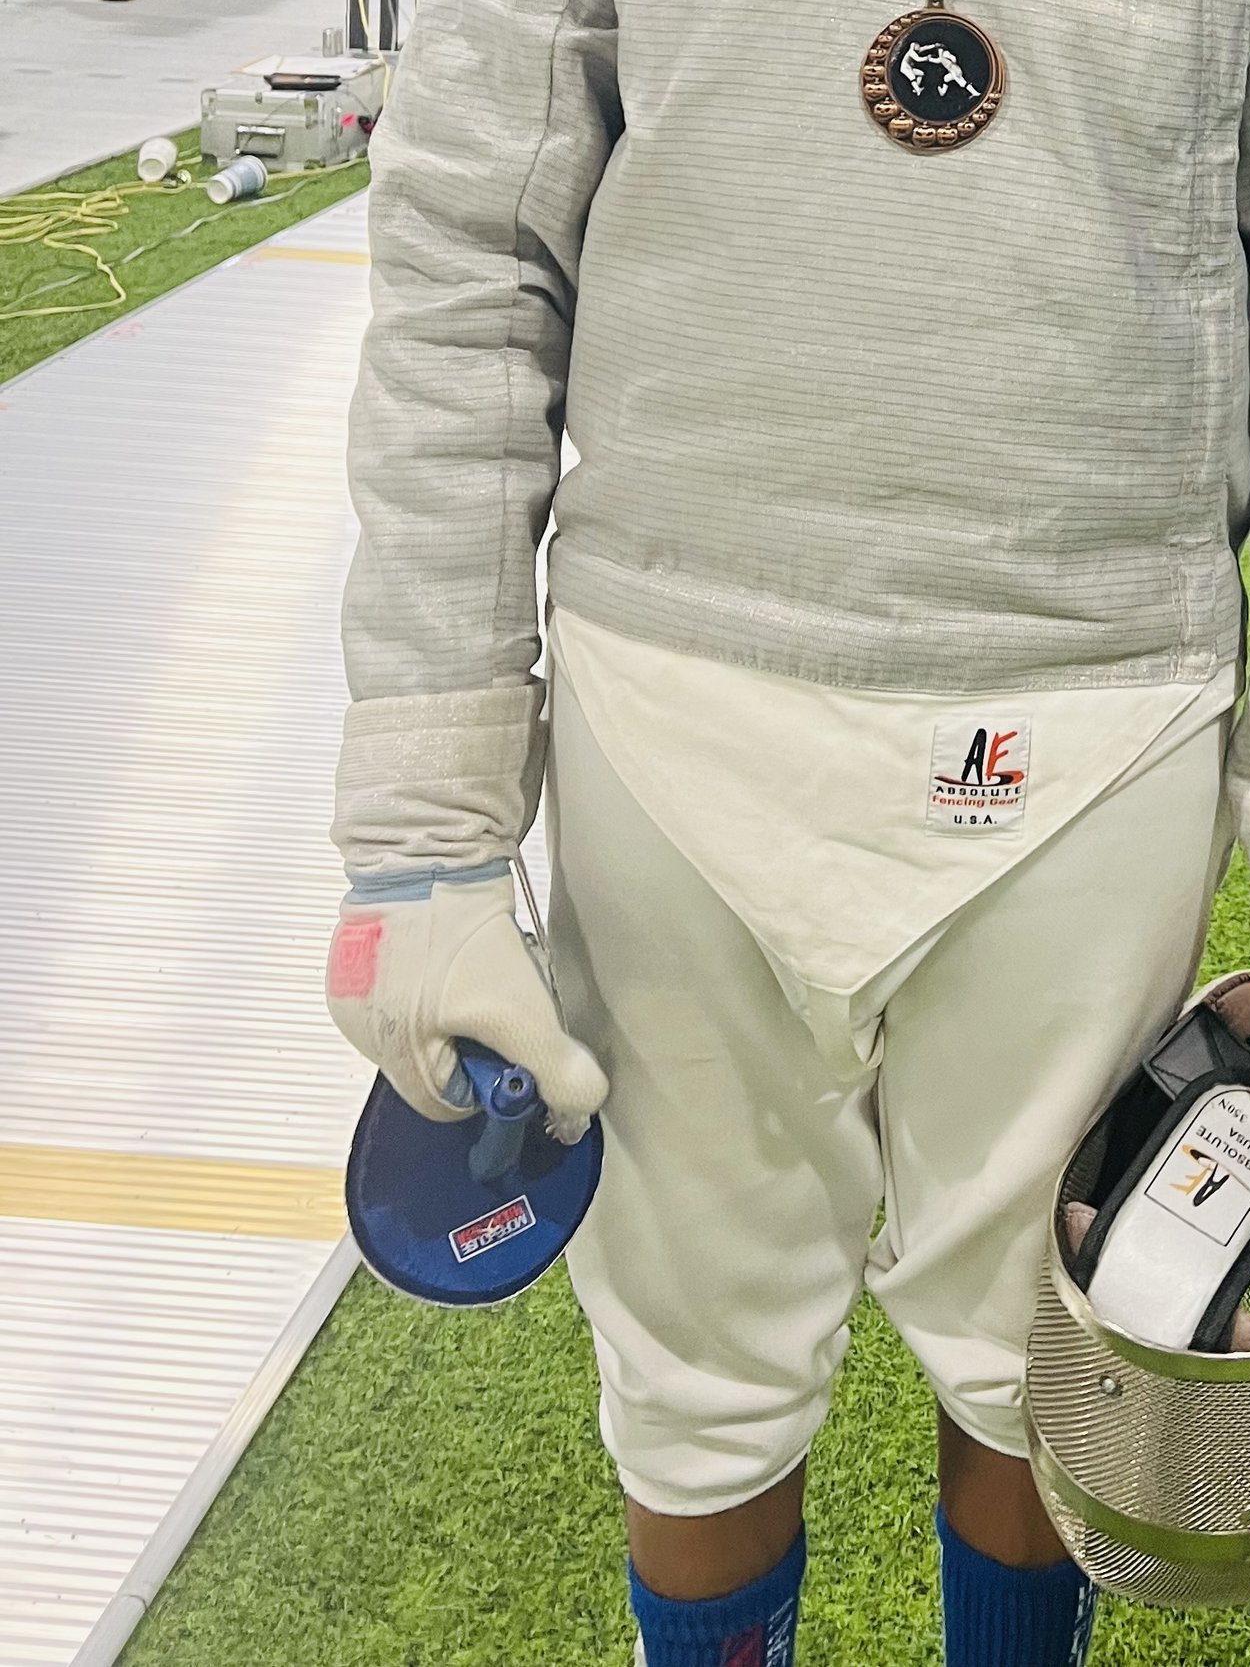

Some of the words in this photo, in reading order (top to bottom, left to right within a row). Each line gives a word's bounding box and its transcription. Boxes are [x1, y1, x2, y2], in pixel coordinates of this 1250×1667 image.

[935, 786, 1021, 797] ABSOLUTE
[932, 794, 985, 808] Fencing
[989, 797, 1019, 806] Gear
[953, 814, 997, 825] U.S.A.
[1218, 1098, 1248, 1123] 350N
